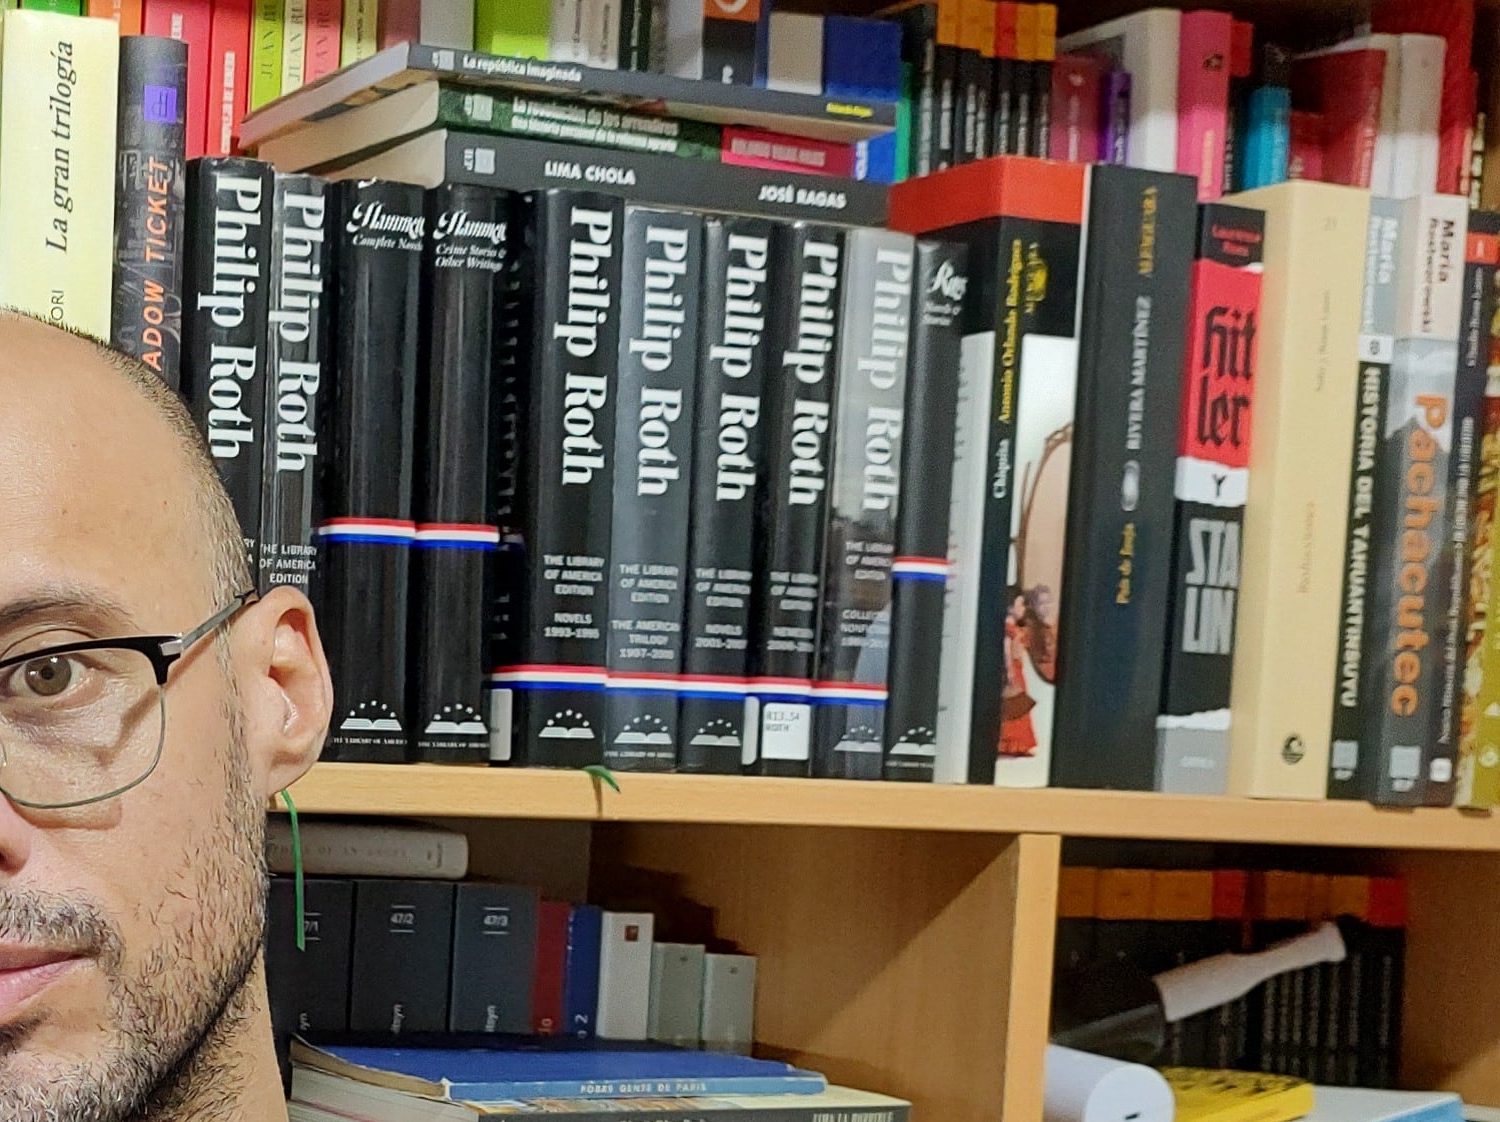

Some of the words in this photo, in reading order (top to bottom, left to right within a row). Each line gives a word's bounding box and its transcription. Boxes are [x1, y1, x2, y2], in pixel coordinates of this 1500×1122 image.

[49, 40, 77, 141] trilogía
[53, 147, 74, 214] gran
[144, 157, 169, 263] TICKET
[544, 160, 583, 180] LIMA
[585, 165, 636, 186] CHOLA
[758, 182, 794, 205] JOSÉ
[796, 190, 848, 210] RAGAS
[45, 217, 68, 253] La
[198, 175, 262, 328] Philip
[269, 190, 326, 343] Philip
[554, 207, 614, 358] Philip
[629, 225, 689, 372] Philip
[710, 234, 769, 379] Philip
[783, 241, 840, 384] Philip
[207, 343, 258, 459] Roth
[276, 363, 321, 473] Roth
[562, 373, 609, 486] Roth
[637, 387, 683, 497] Roth
[716, 393, 761, 502] Roth
[788, 399, 830, 507] Roth
